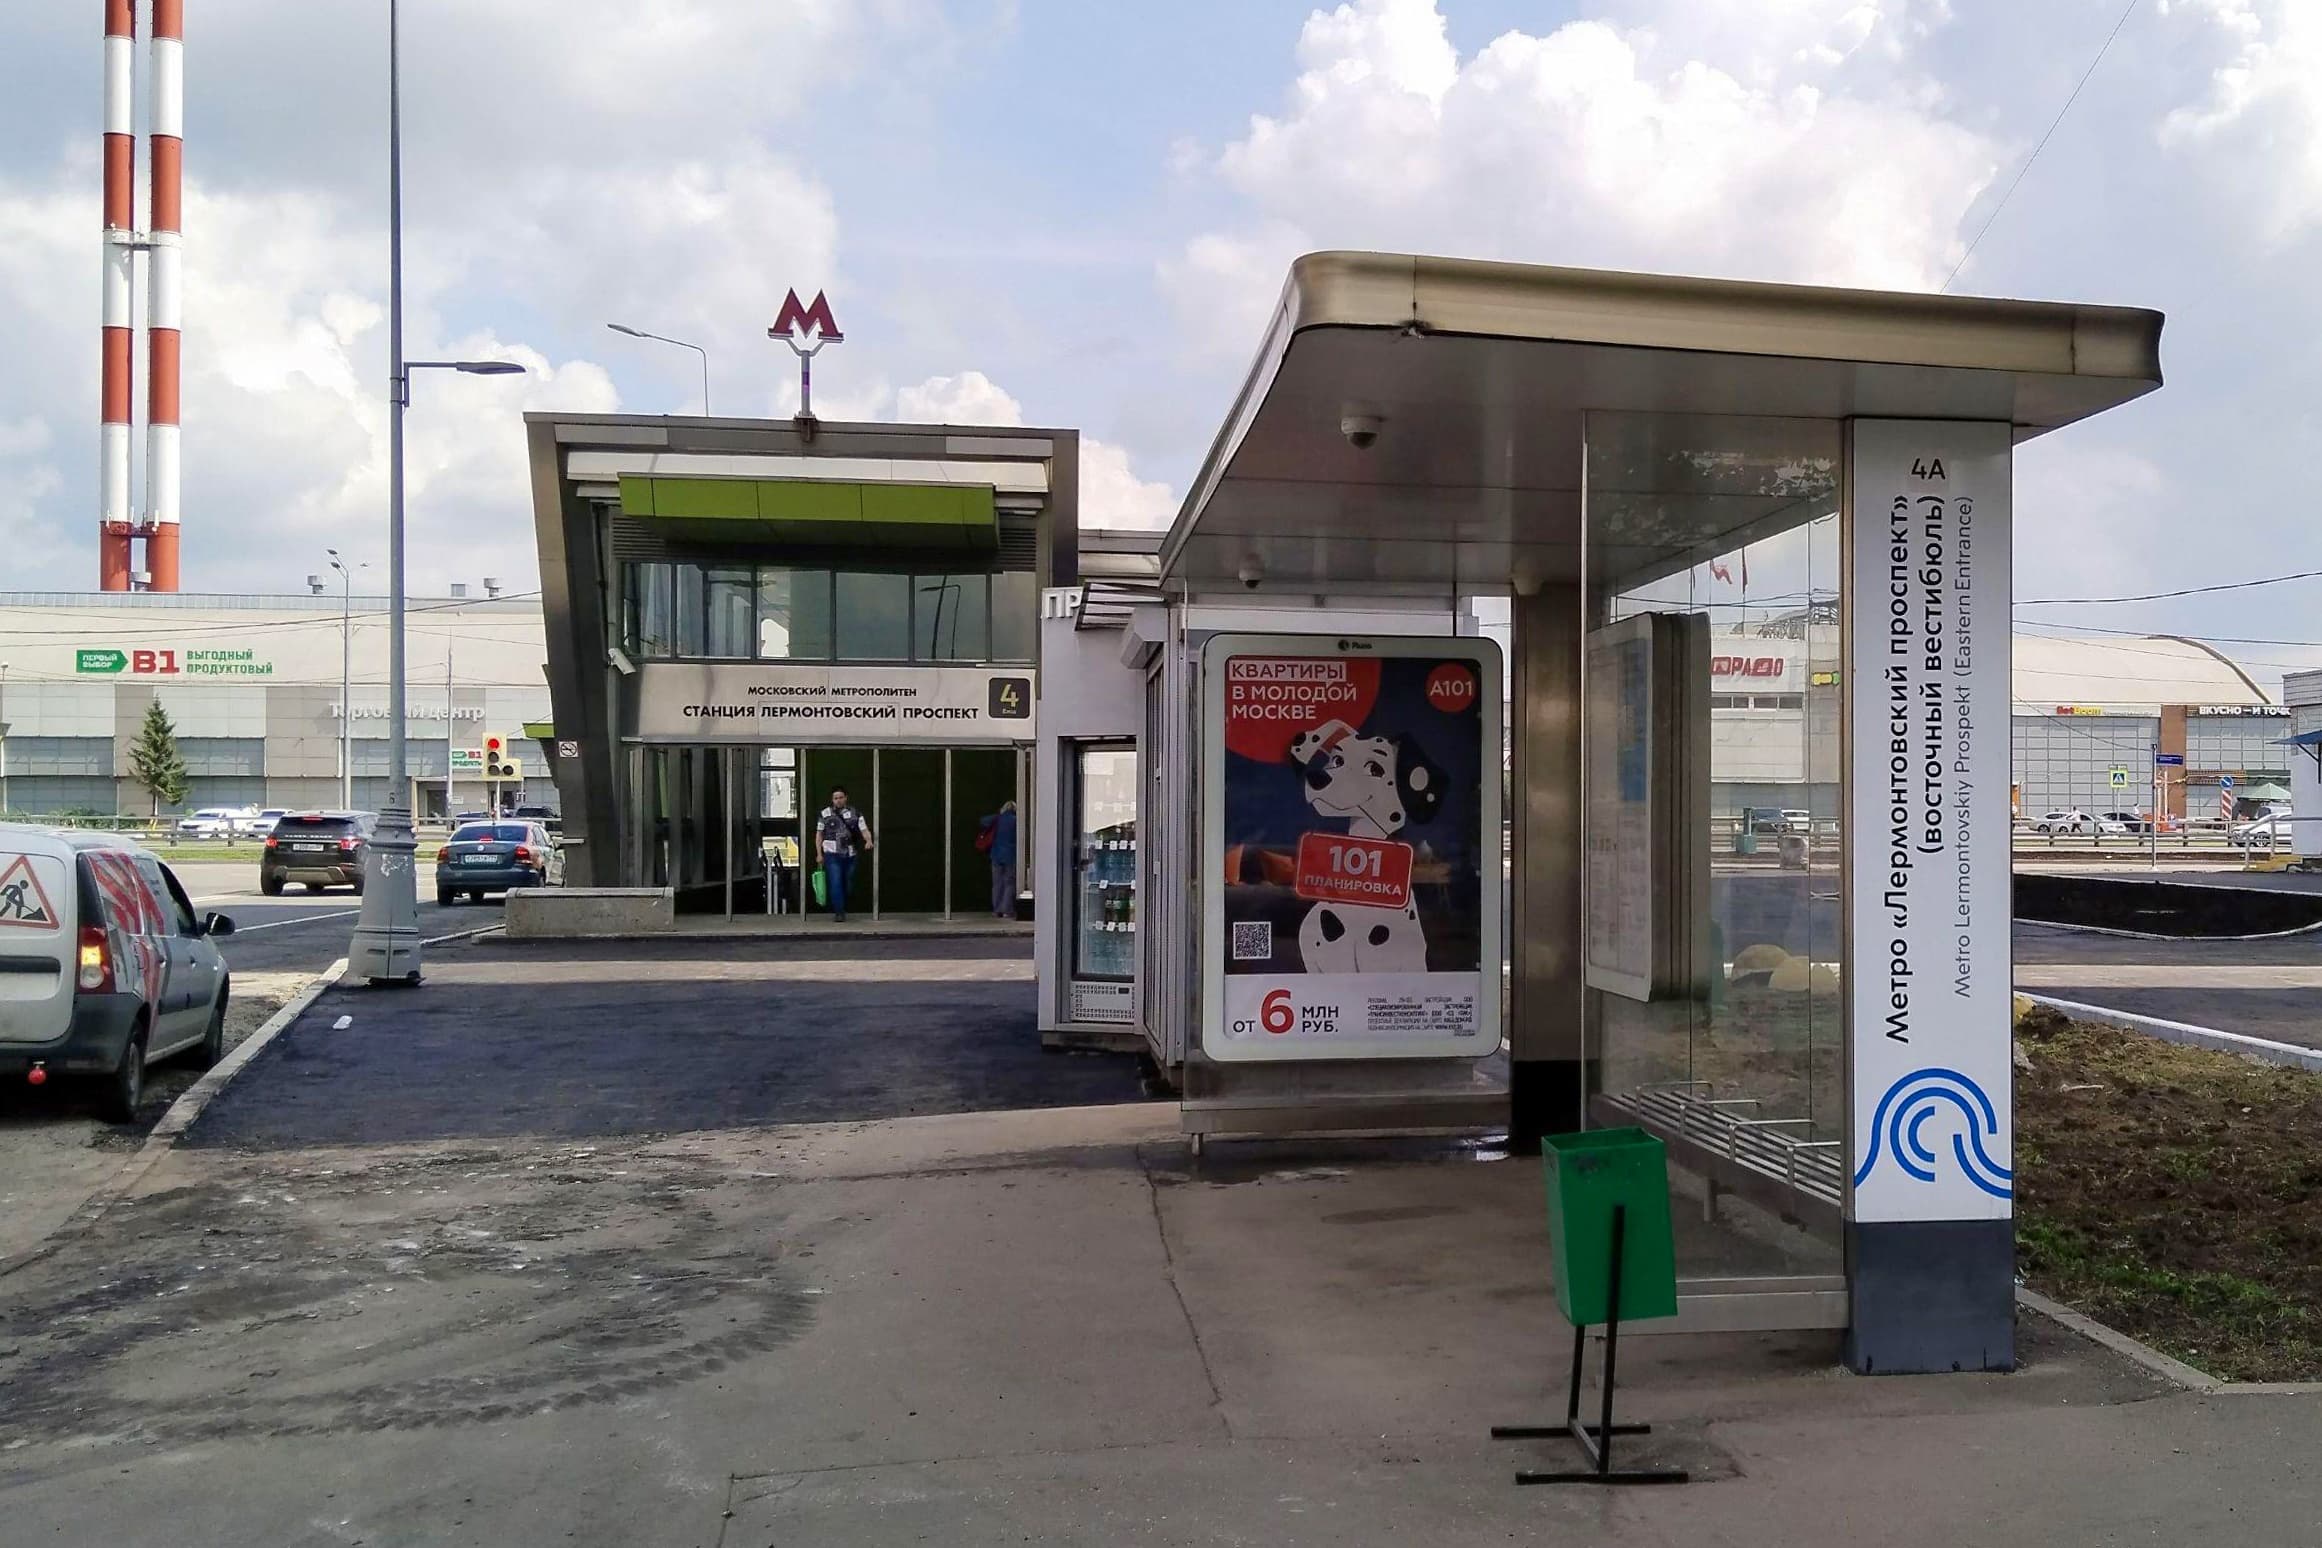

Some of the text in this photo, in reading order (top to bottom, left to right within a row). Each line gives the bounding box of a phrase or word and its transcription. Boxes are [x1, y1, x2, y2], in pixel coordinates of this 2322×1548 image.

[1911, 458, 1946, 480] 4А
[132, 650, 180, 673] В1
[186, 648, 253, 661] ВЫГОДНЫЙ
[186, 662, 273, 675] ПРОДУКТОВЫЙ
[1231, 663, 1344, 679] КВАРТИРЫ
[1916, 495, 1945, 854] (восточный вестибюль)
[747, 685, 917, 697] МОСКОВСКИЙ МЕТРОПОЛИТЕН
[1000, 683, 1020, 707] 4
[1231, 683, 1358, 704] В МОЛОДОЙ
[1430, 680, 1473, 696] А101
[329, 703, 425, 721] Торговй
[683, 705, 979, 719] СТАНЦИЯ ЛЕРМОНТОВСКИЙ ПРОСПЕКТ
[1231, 704, 1317, 719] МОСКВЕ
[2199, 706, 2242, 715] ВКУСНО
[2252, 706, 2261, 715] И
[1953, 496, 1974, 998] Metro Lermontovskiy Prospekt (Eastern Entrance)
[1884, 495, 1914, 1044] Метро «Лермонтовский проспект»
[1328, 845, 1383, 878] 101
[1303, 874, 1402, 897] ПЛАНИРОВКА
[1232, 988, 1295, 1034] ОТ 6
[1301, 1005, 1339, 1019] МЛН
[1301, 1020, 1339, 1033] РУБ.
